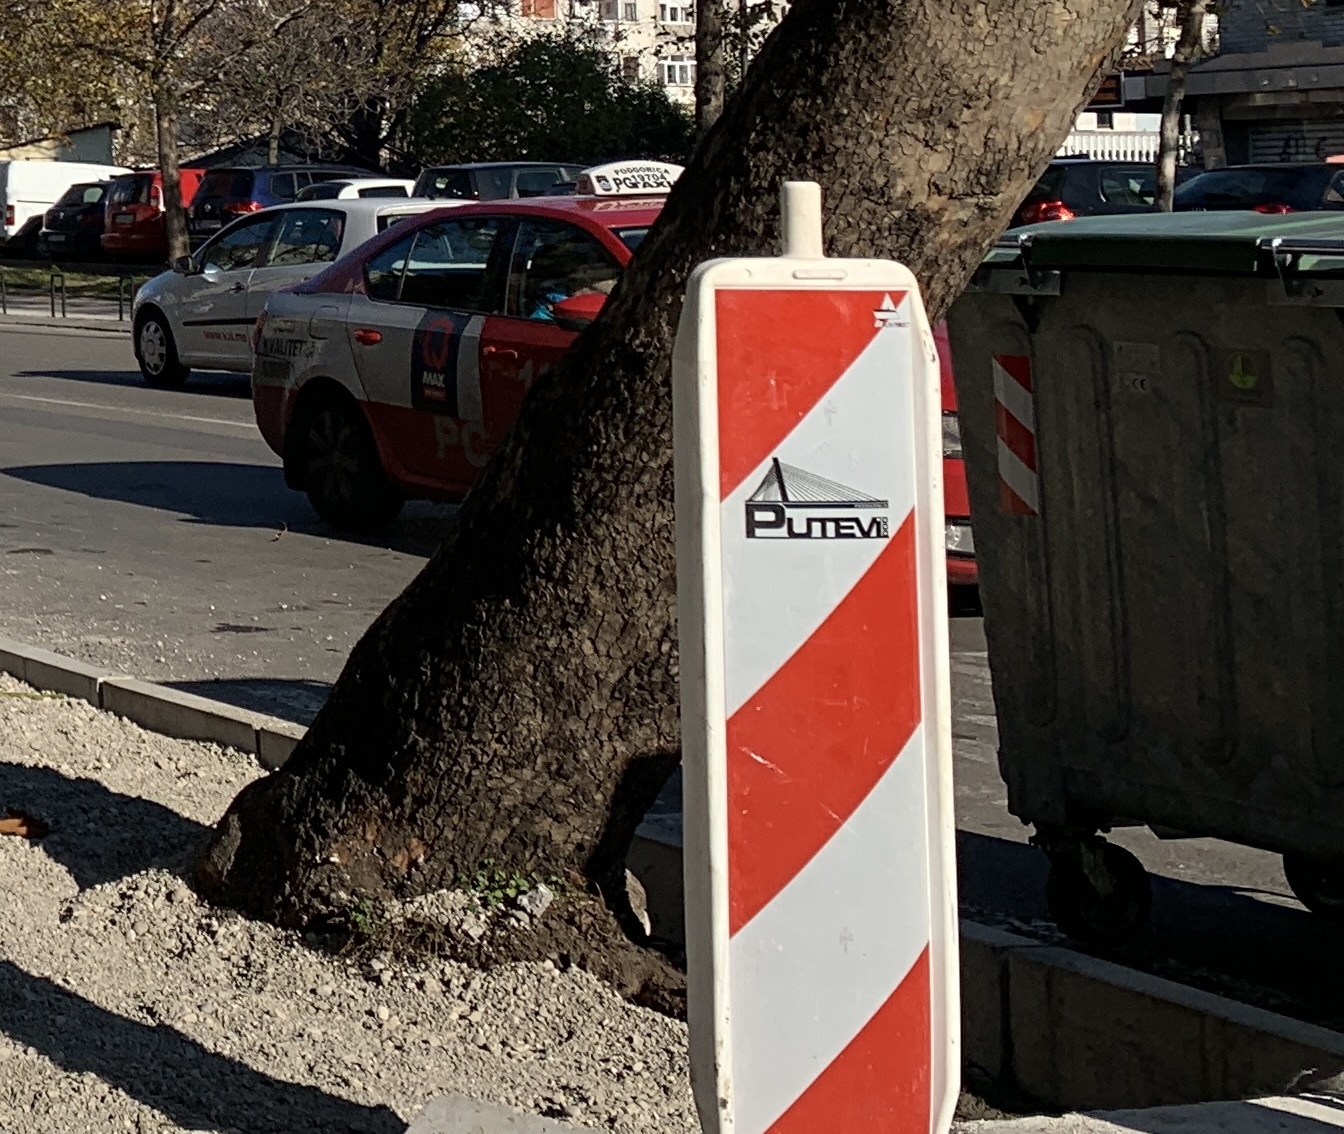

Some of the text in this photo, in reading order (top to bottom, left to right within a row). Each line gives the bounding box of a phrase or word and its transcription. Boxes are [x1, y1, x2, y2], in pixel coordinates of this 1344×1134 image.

[614, 166, 670, 176] PODGORICA
[422, 370, 446, 388] MAX
[745, 503, 881, 539] PUTEVI
